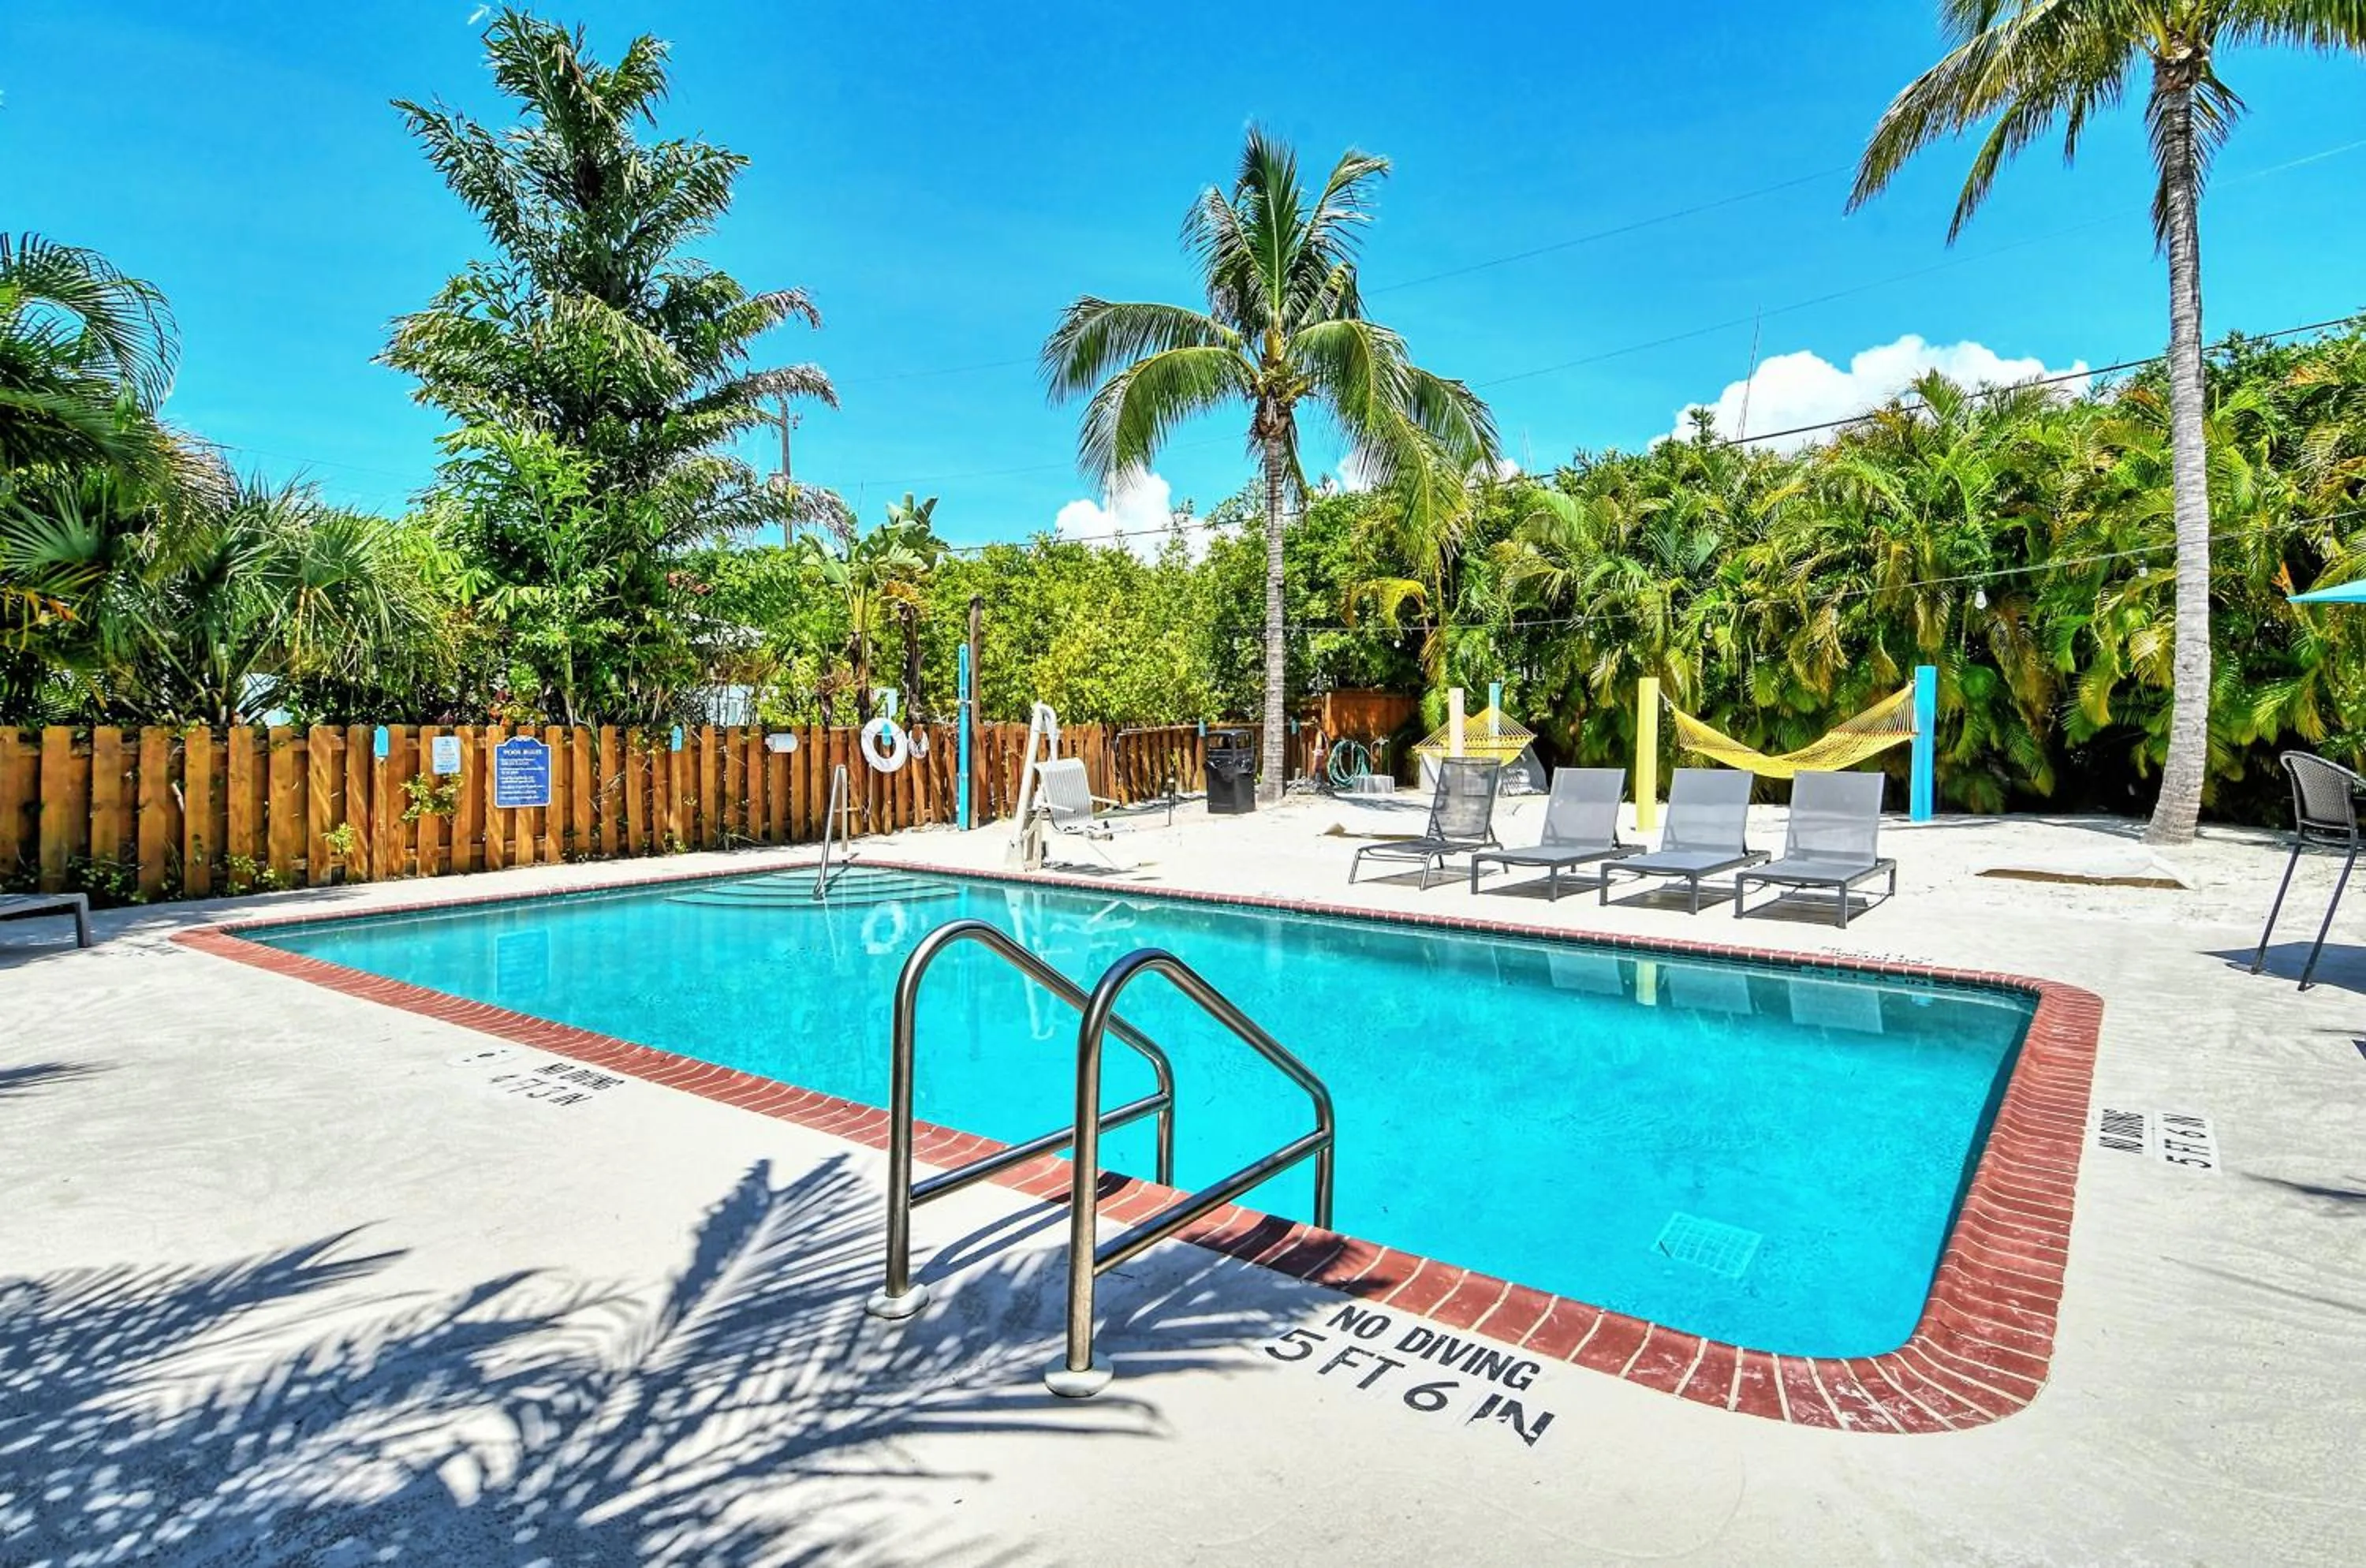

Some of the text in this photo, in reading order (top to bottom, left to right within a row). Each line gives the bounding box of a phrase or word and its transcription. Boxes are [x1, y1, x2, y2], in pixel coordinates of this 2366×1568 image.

[2099, 1137, 2144, 1155] NO
[2162, 1112, 2212, 1168] 5 FT 6 IN
[1326, 1305, 1540, 1391] NO DIVING
[1264, 1328, 1555, 1447] 5 FT 6 IN
